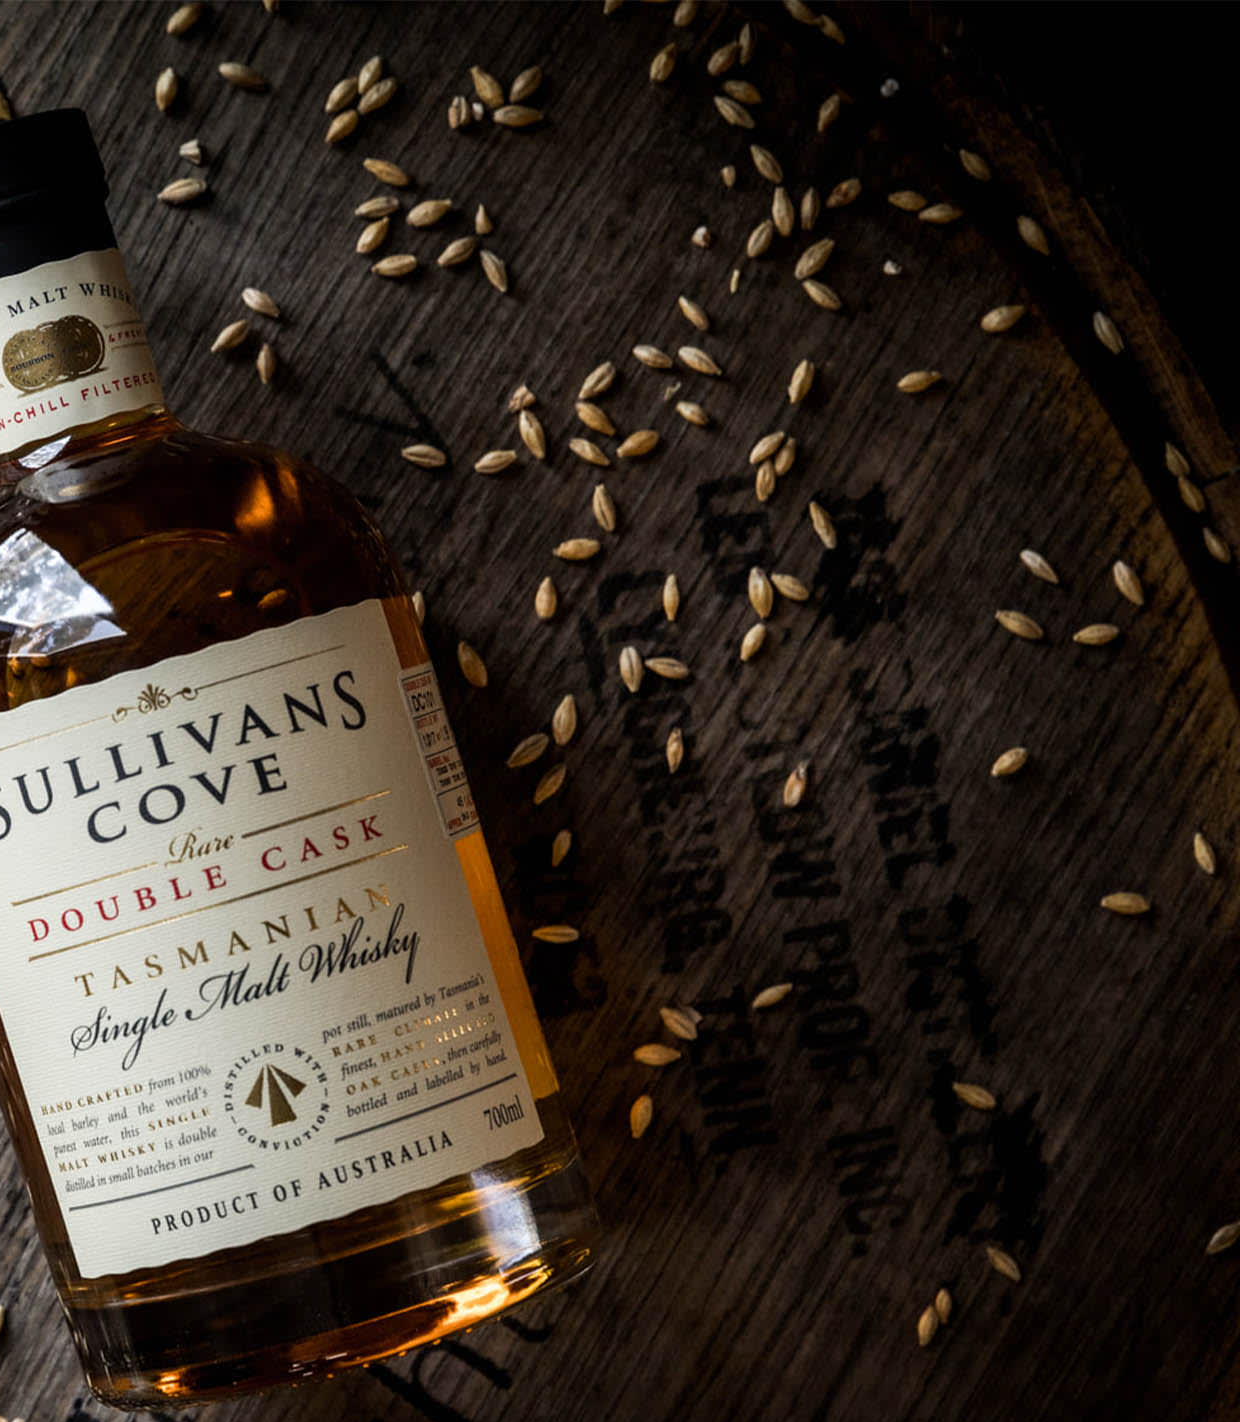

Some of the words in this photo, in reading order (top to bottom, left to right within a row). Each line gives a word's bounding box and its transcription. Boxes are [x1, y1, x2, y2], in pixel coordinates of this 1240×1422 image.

[7, 286, 68, 318] MALT
[10, 351, 56, 372] BOURBON
[81, 372, 156, 401] FILTERED
[86, 752, 288, 845] COVE
[163, 829, 235, 868] Rare
[27, 864, 228, 943] DOUBLE
[261, 814, 385, 873] CASK
[73, 882, 393, 998] TASMANIAN
[69, 987, 178, 1071] Single
[184, 954, 291, 1024] Malt
[297, 902, 422, 985] Whisky
[322, 1025, 342, 1044] pot
[346, 1014, 372, 1034] still,
[376, 999, 421, 1024] matured
[424, 993, 436, 1009] by
[438, 972, 486, 1000] Tasmania's
[294, 1047, 327, 1083] WITH
[331, 1034, 378, 1058] RARE
[341, 1056, 377, 1081] finest,
[346, 1076, 382, 1096] OAK
[448, 1045, 468, 1061] then
[469, 1031, 502, 1055] carefully
[41, 1101, 72, 1116] HAND
[77, 1083, 144, 1108] CRAFTED
[148, 1077, 175, 1094] from
[178, 1065, 212, 1084] 100%
[224, 1043, 284, 1112] DISTILLED
[346, 1093, 388, 1118] bottled
[396, 1085, 419, 1101] and
[425, 1066, 465, 1091] labelled
[469, 1061, 481, 1076] by
[71, 1115, 100, 1132] barley
[107, 1107, 128, 1123] and
[137, 1100, 155, 1116] the
[164, 1085, 208, 1108] world's
[82, 1135, 113, 1150] water,
[120, 1126, 140, 1141] this
[147, 1107, 210, 1131] SINGLE
[238, 1103, 330, 1151] CONVICTION
[483, 1095, 524, 1131] 700ml
[58, 1157, 89, 1173] MALT
[97, 1142, 157, 1164] WHISKY
[164, 1137, 174, 1150] is
[177, 1126, 217, 1146] double
[97, 1174, 107, 1186] in
[108, 1166, 135, 1184] small
[136, 1159, 176, 1178] batches
[178, 1154, 191, 1167] in
[193, 1149, 214, 1164] our
[151, 1190, 262, 1236] PRODUCT
[272, 1180, 303, 1204] OF
[316, 1129, 454, 1191] AUSTRALIA
